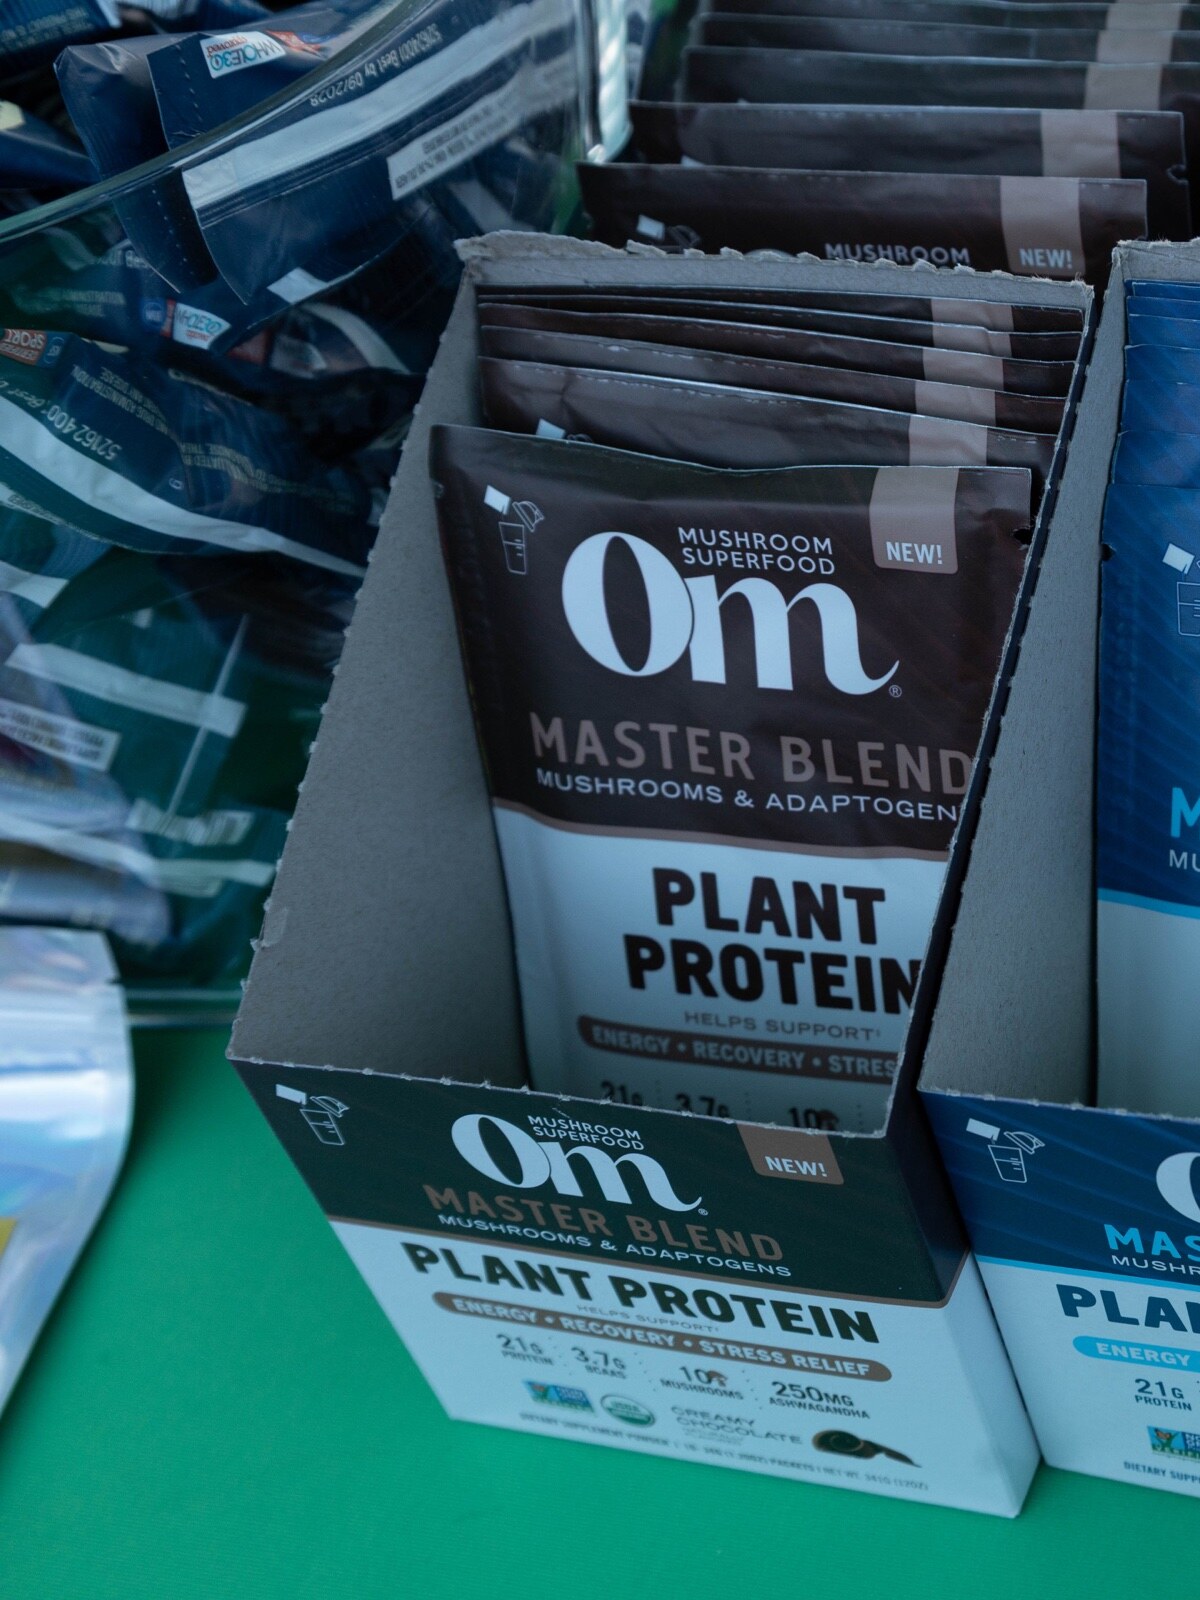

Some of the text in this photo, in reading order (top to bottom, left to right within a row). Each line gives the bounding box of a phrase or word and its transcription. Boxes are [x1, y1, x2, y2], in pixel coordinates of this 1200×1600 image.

[824, 243, 971, 266] MUSHROOM
[1019, 248, 1073, 269] NEW!
[677, 526, 834, 556] MUSHROOM
[886, 541, 944, 566] NEW!
[682, 548, 836, 576] SUPERFOOD
[562, 531, 900, 696] Om
[529, 712, 971, 795] MASTER BLEND
[536, 767, 964, 822] MUSHROOMS & ADAPTOGEN
[652, 867, 886, 945] PLANT
[623, 933, 923, 1016] PROTEIN
[684, 1010, 758, 1032] HELPS
[591, 1027, 897, 1078] ENERGY RECOVERY STRES
[527, 1115, 641, 1140] MUSHROOM
[533, 1127, 645, 1151] SUPERFOOD
[451, 1113, 702, 1212] Om
[765, 1155, 828, 1178] NEW!
[422, 1184, 784, 1261] MASTER BLEND
[438, 1214, 792, 1278] MUSHROOMS & ADAPTOGENS
[400, 1241, 880, 1344] PLANT PROTEIN
[576, 1304, 632, 1320] HELPS
[452, 1299, 870, 1377] ENERGY RECOVERY STRESS RELIEF
[496, 1333, 544, 1356] 21G
[501, 1350, 553, 1366] PROTEIN
[571, 1346, 627, 1370] 3.7G
[1096, 1342, 1191, 1367] ENERGY
[584, 1364, 627, 1380] BCAAS
[679, 1366, 711, 1385] 10
[660, 1378, 744, 1401] MUSHROOMS
[771, 1380, 855, 1407] 250MG
[1134, 1378, 1185, 1400] 21G
[670, 1404, 757, 1428] CREAMY
[769, 1396, 870, 1420] ASHWAGANDHA
[1134, 1395, 1192, 1412] PROTEIN
[676, 1414, 804, 1446] CHOCOLATE
[1123, 1461, 1166, 1477] DIETARY
